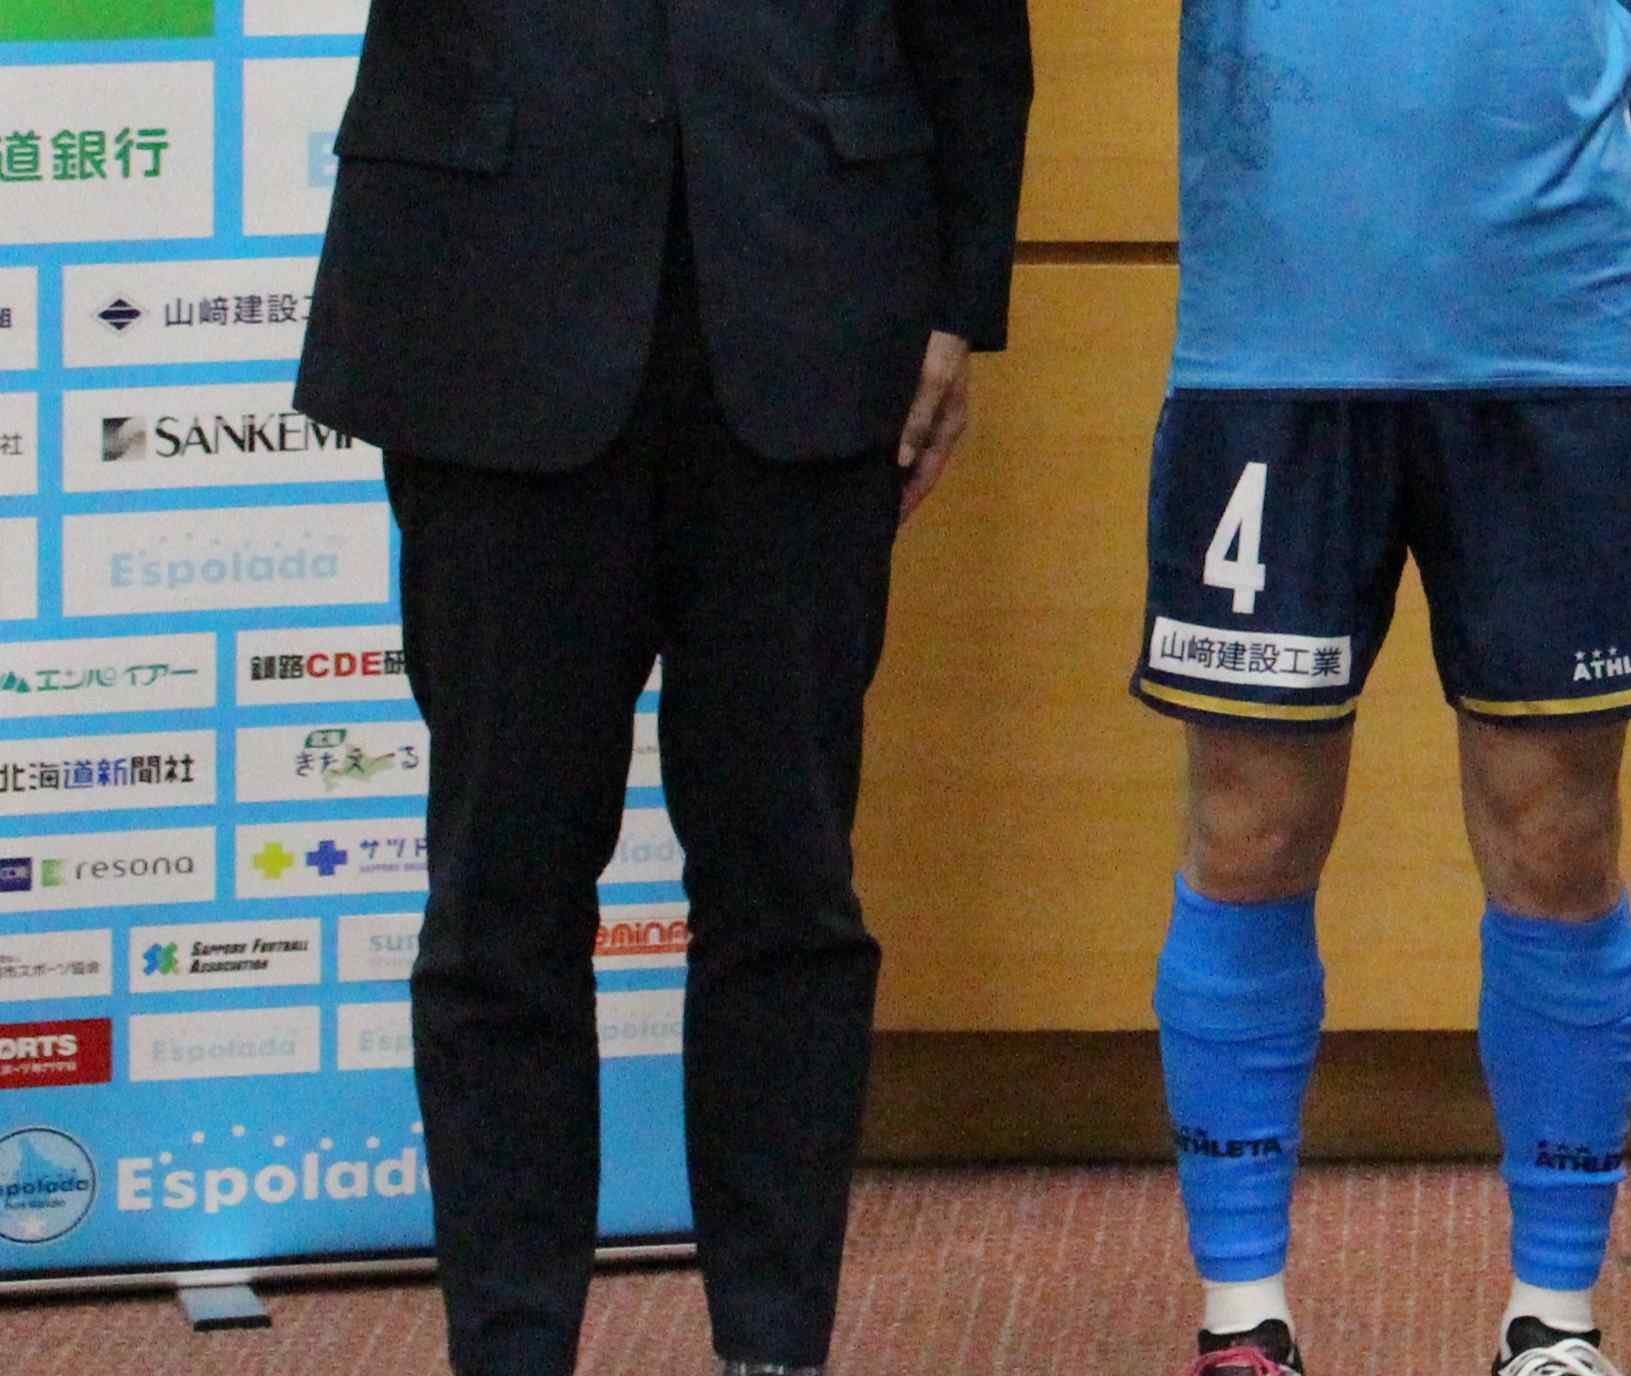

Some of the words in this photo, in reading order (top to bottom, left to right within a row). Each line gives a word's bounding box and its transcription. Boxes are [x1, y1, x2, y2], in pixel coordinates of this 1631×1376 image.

[1202, 461, 1268, 614] 4
[75, 854, 195, 881] resona
[117, 1146, 431, 1213] Espolad
